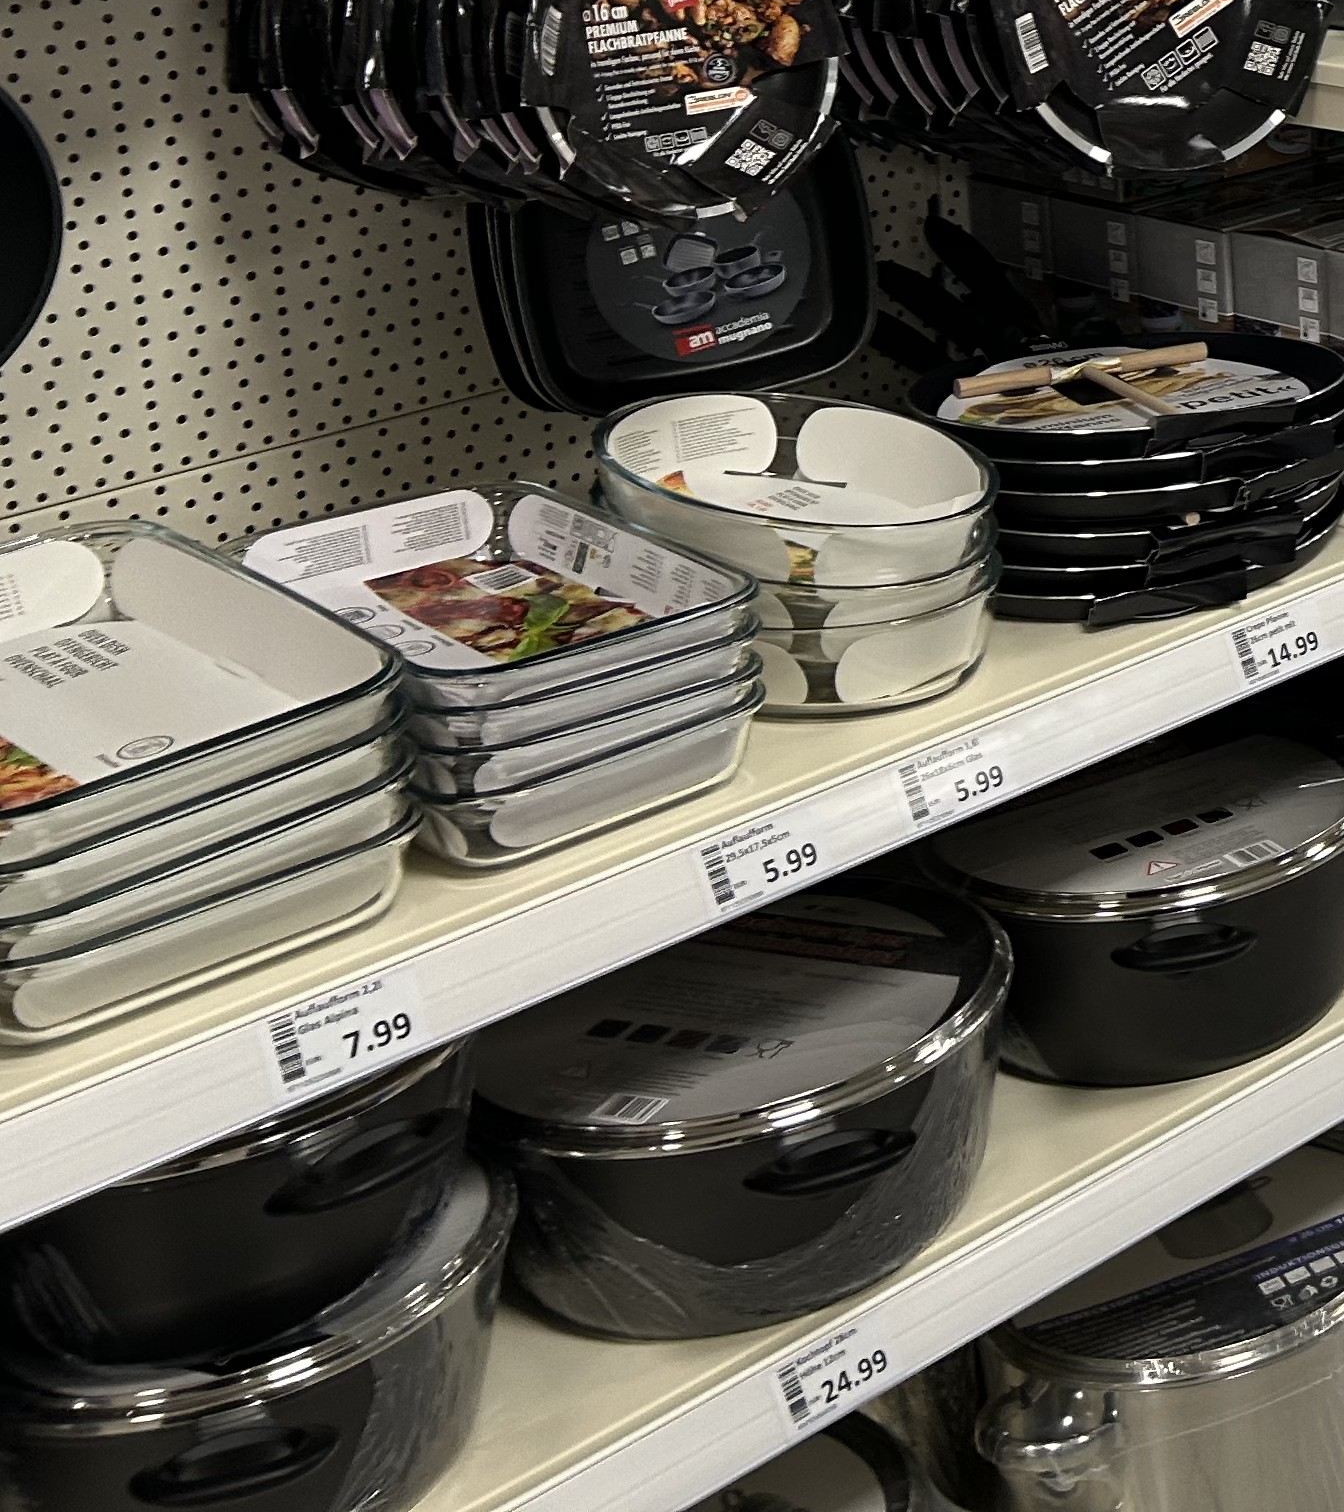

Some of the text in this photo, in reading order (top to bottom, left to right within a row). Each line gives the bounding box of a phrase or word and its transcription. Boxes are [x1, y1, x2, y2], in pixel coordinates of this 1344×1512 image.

[585, 20, 638, 39] PREMIUM
[588, 28, 688, 54] FLACHBRATPFANNE
[717, 321, 773, 345] mugnano
[1267, 631, 1318, 668] 14.99
[954, 765, 1004, 802] 5.99
[722, 822, 775, 850] Auflaufform
[762, 843, 818, 883] 5.99
[342, 1012, 411, 1058] 7.99
[821, 1349, 887, 1404] 24.99
